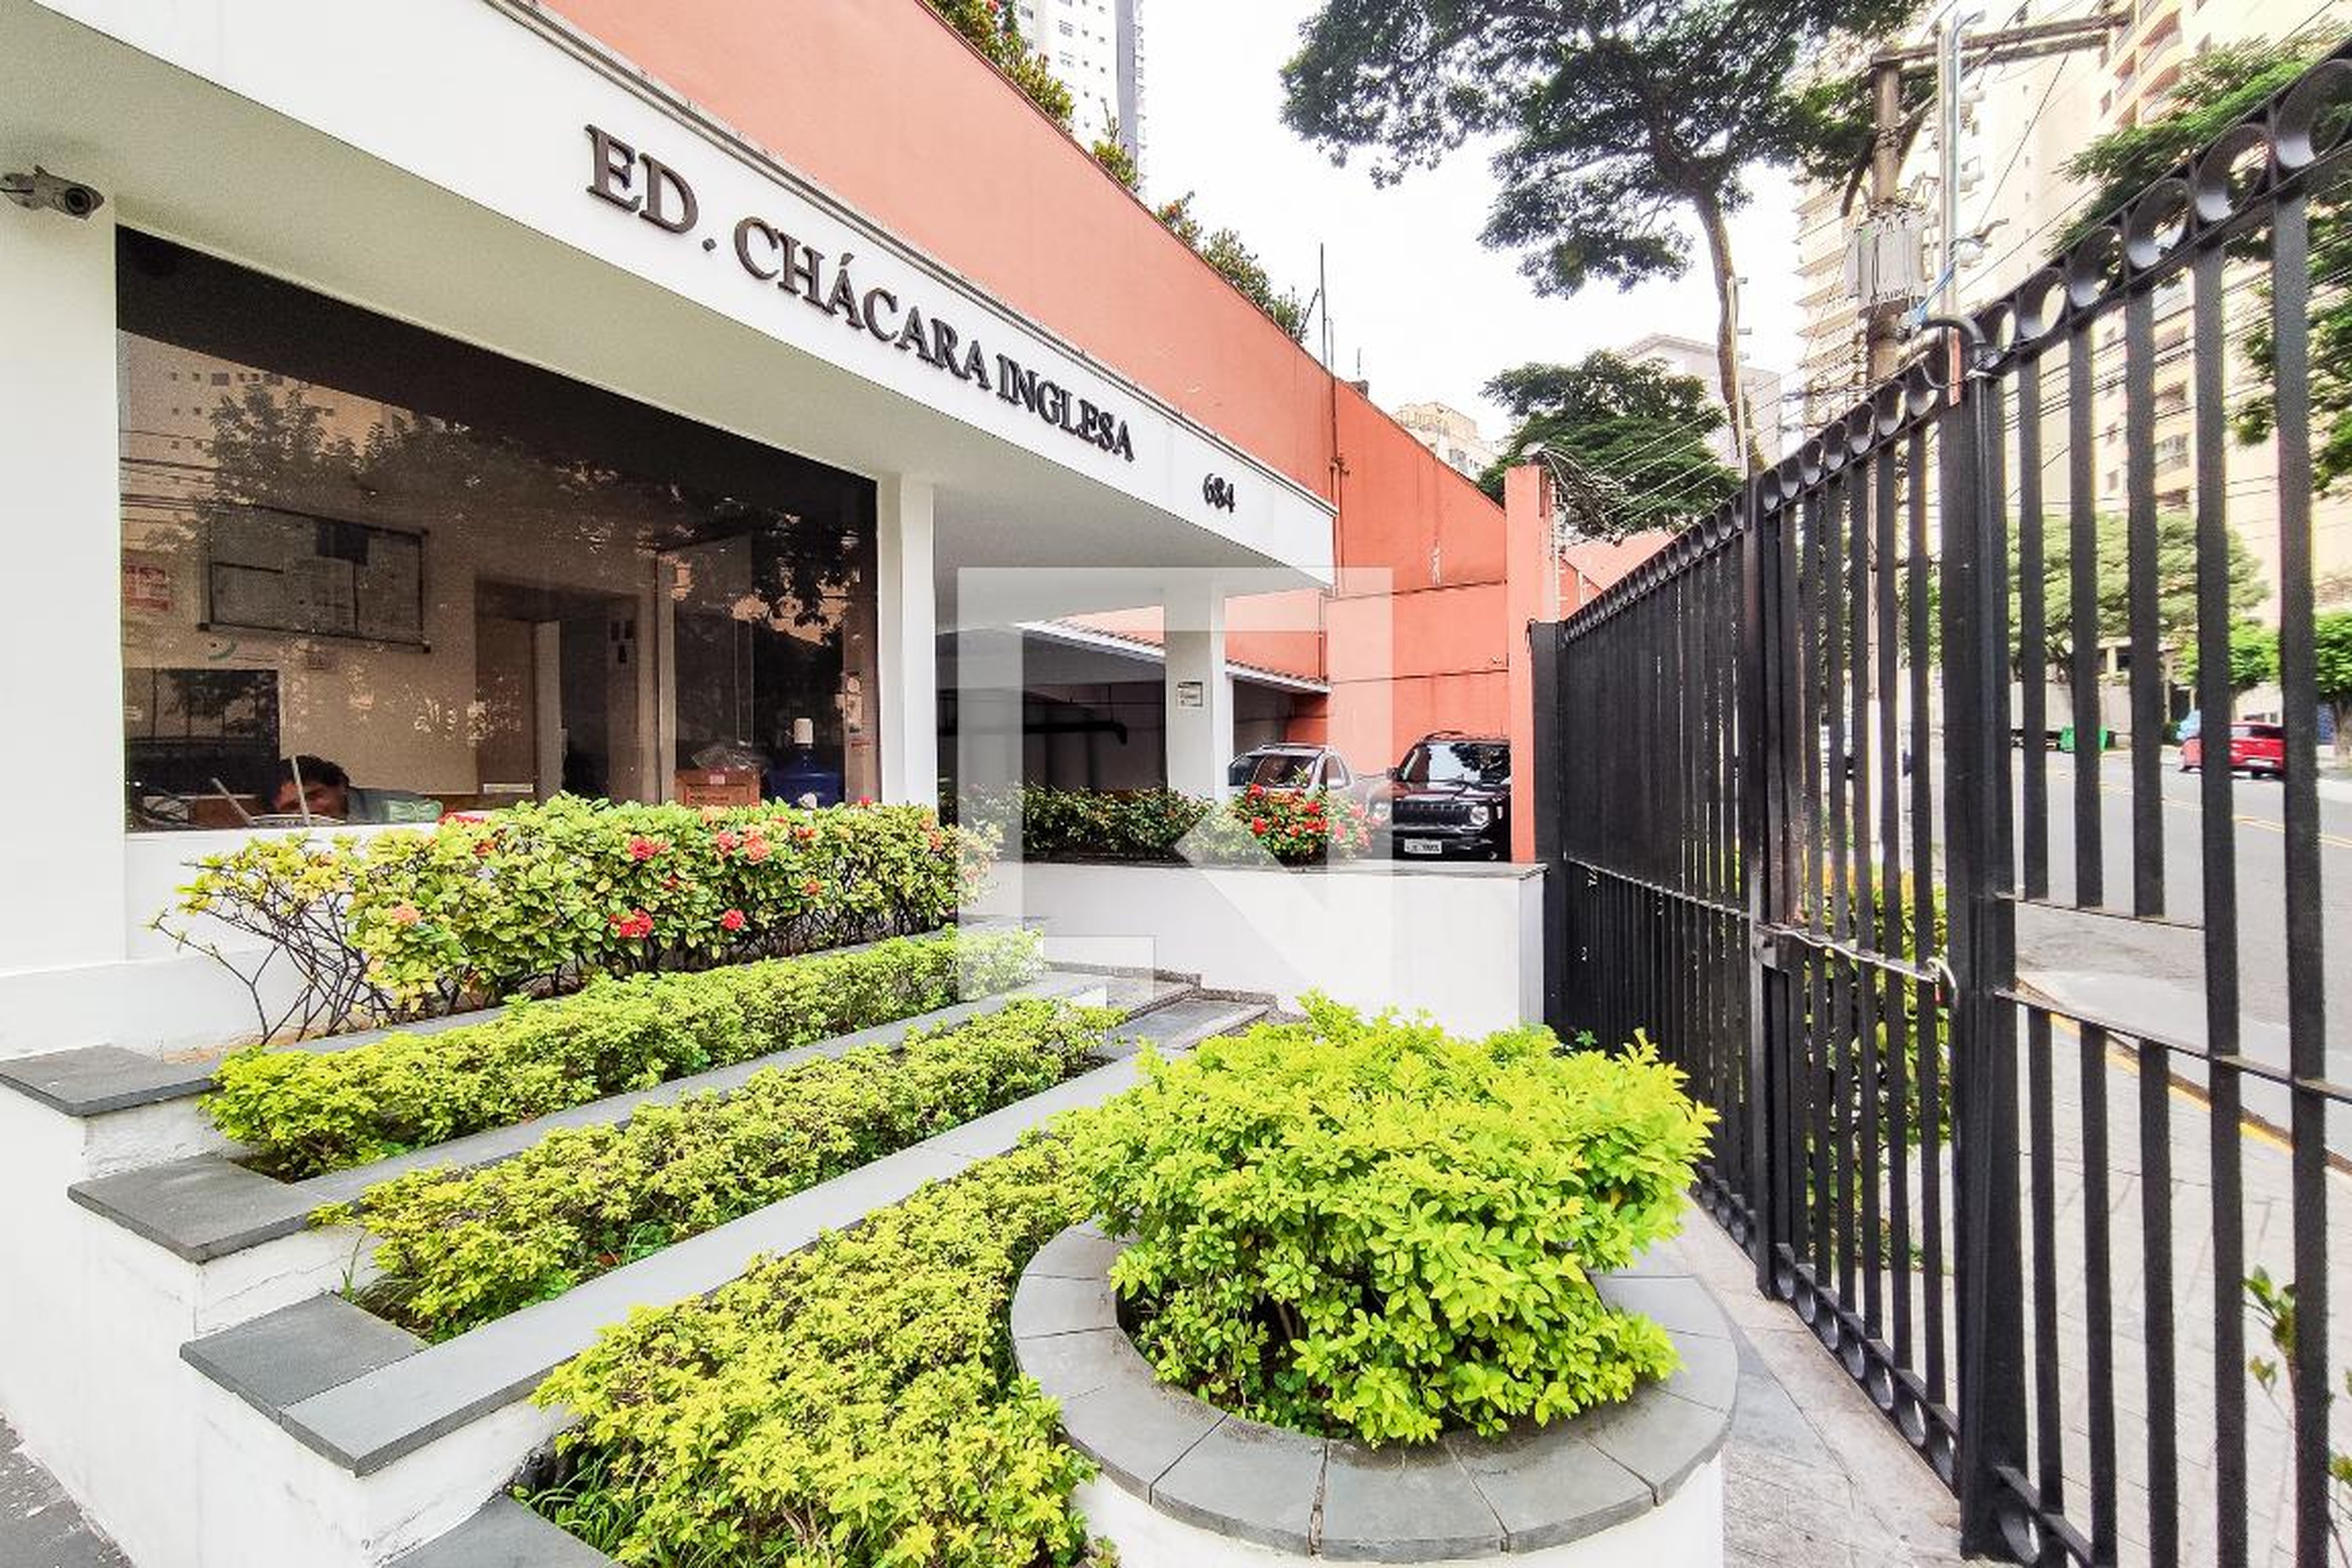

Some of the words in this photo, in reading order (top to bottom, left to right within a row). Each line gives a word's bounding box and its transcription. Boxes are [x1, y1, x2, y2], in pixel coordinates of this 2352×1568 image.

[734, 216, 992, 391] CHÁCARA
[996, 353, 1135, 462] INGLESA
[1202, 473, 1235, 513] 684
